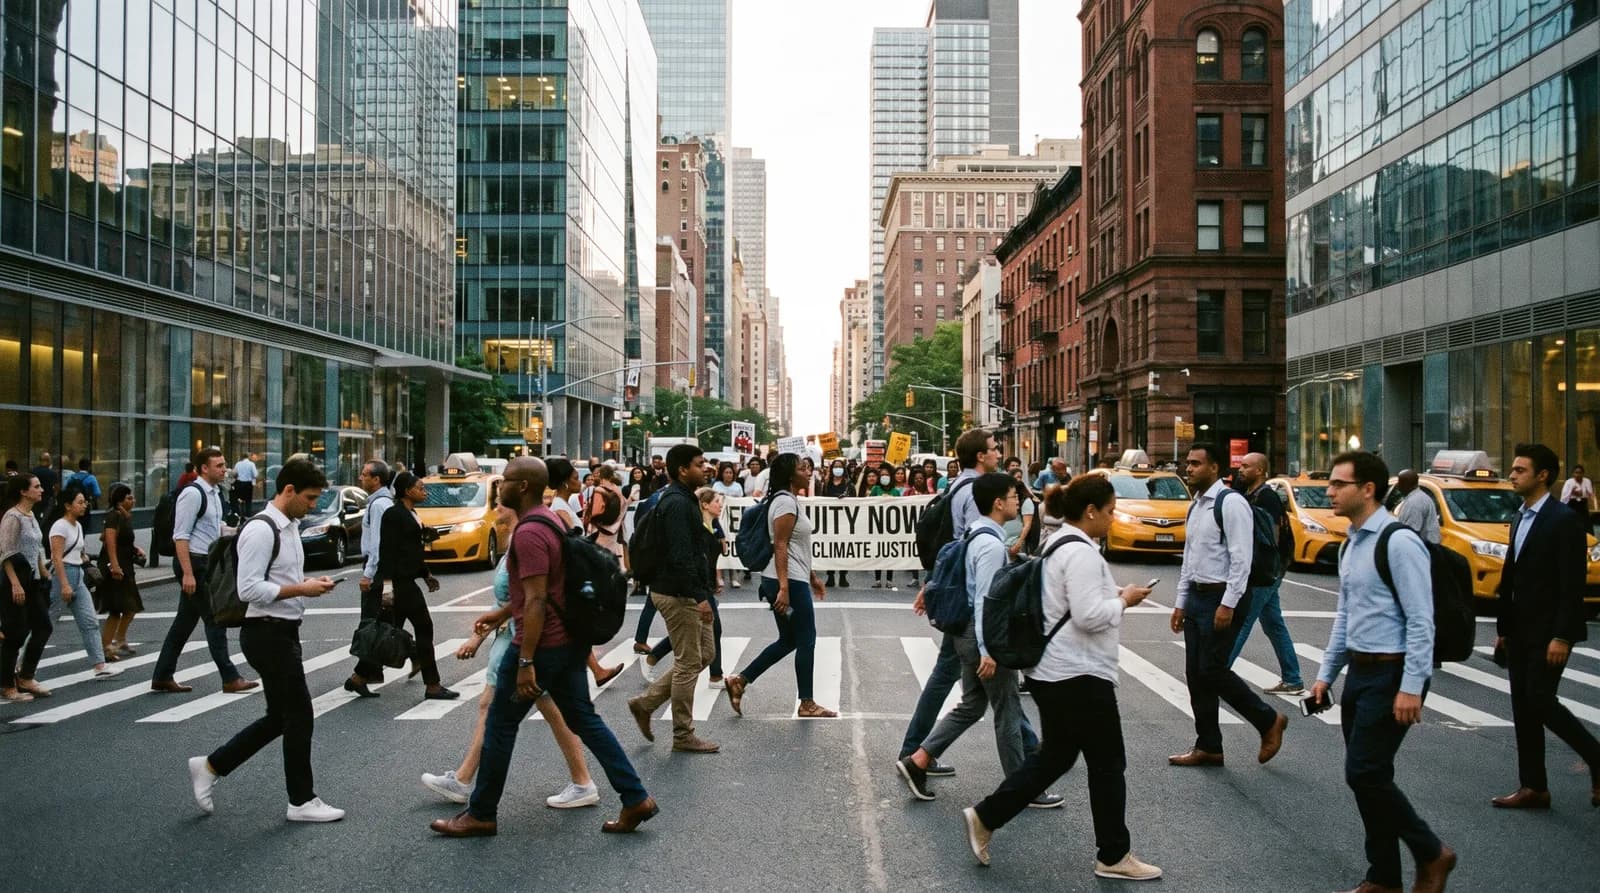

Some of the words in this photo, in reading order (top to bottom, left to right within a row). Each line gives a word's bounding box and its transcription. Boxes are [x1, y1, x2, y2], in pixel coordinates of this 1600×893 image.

[805, 505, 860, 535] UITY
[868, 505, 925, 534] NOW
[812, 541, 871, 558] CLIMATE
[875, 541, 920, 558] JUSTIC
